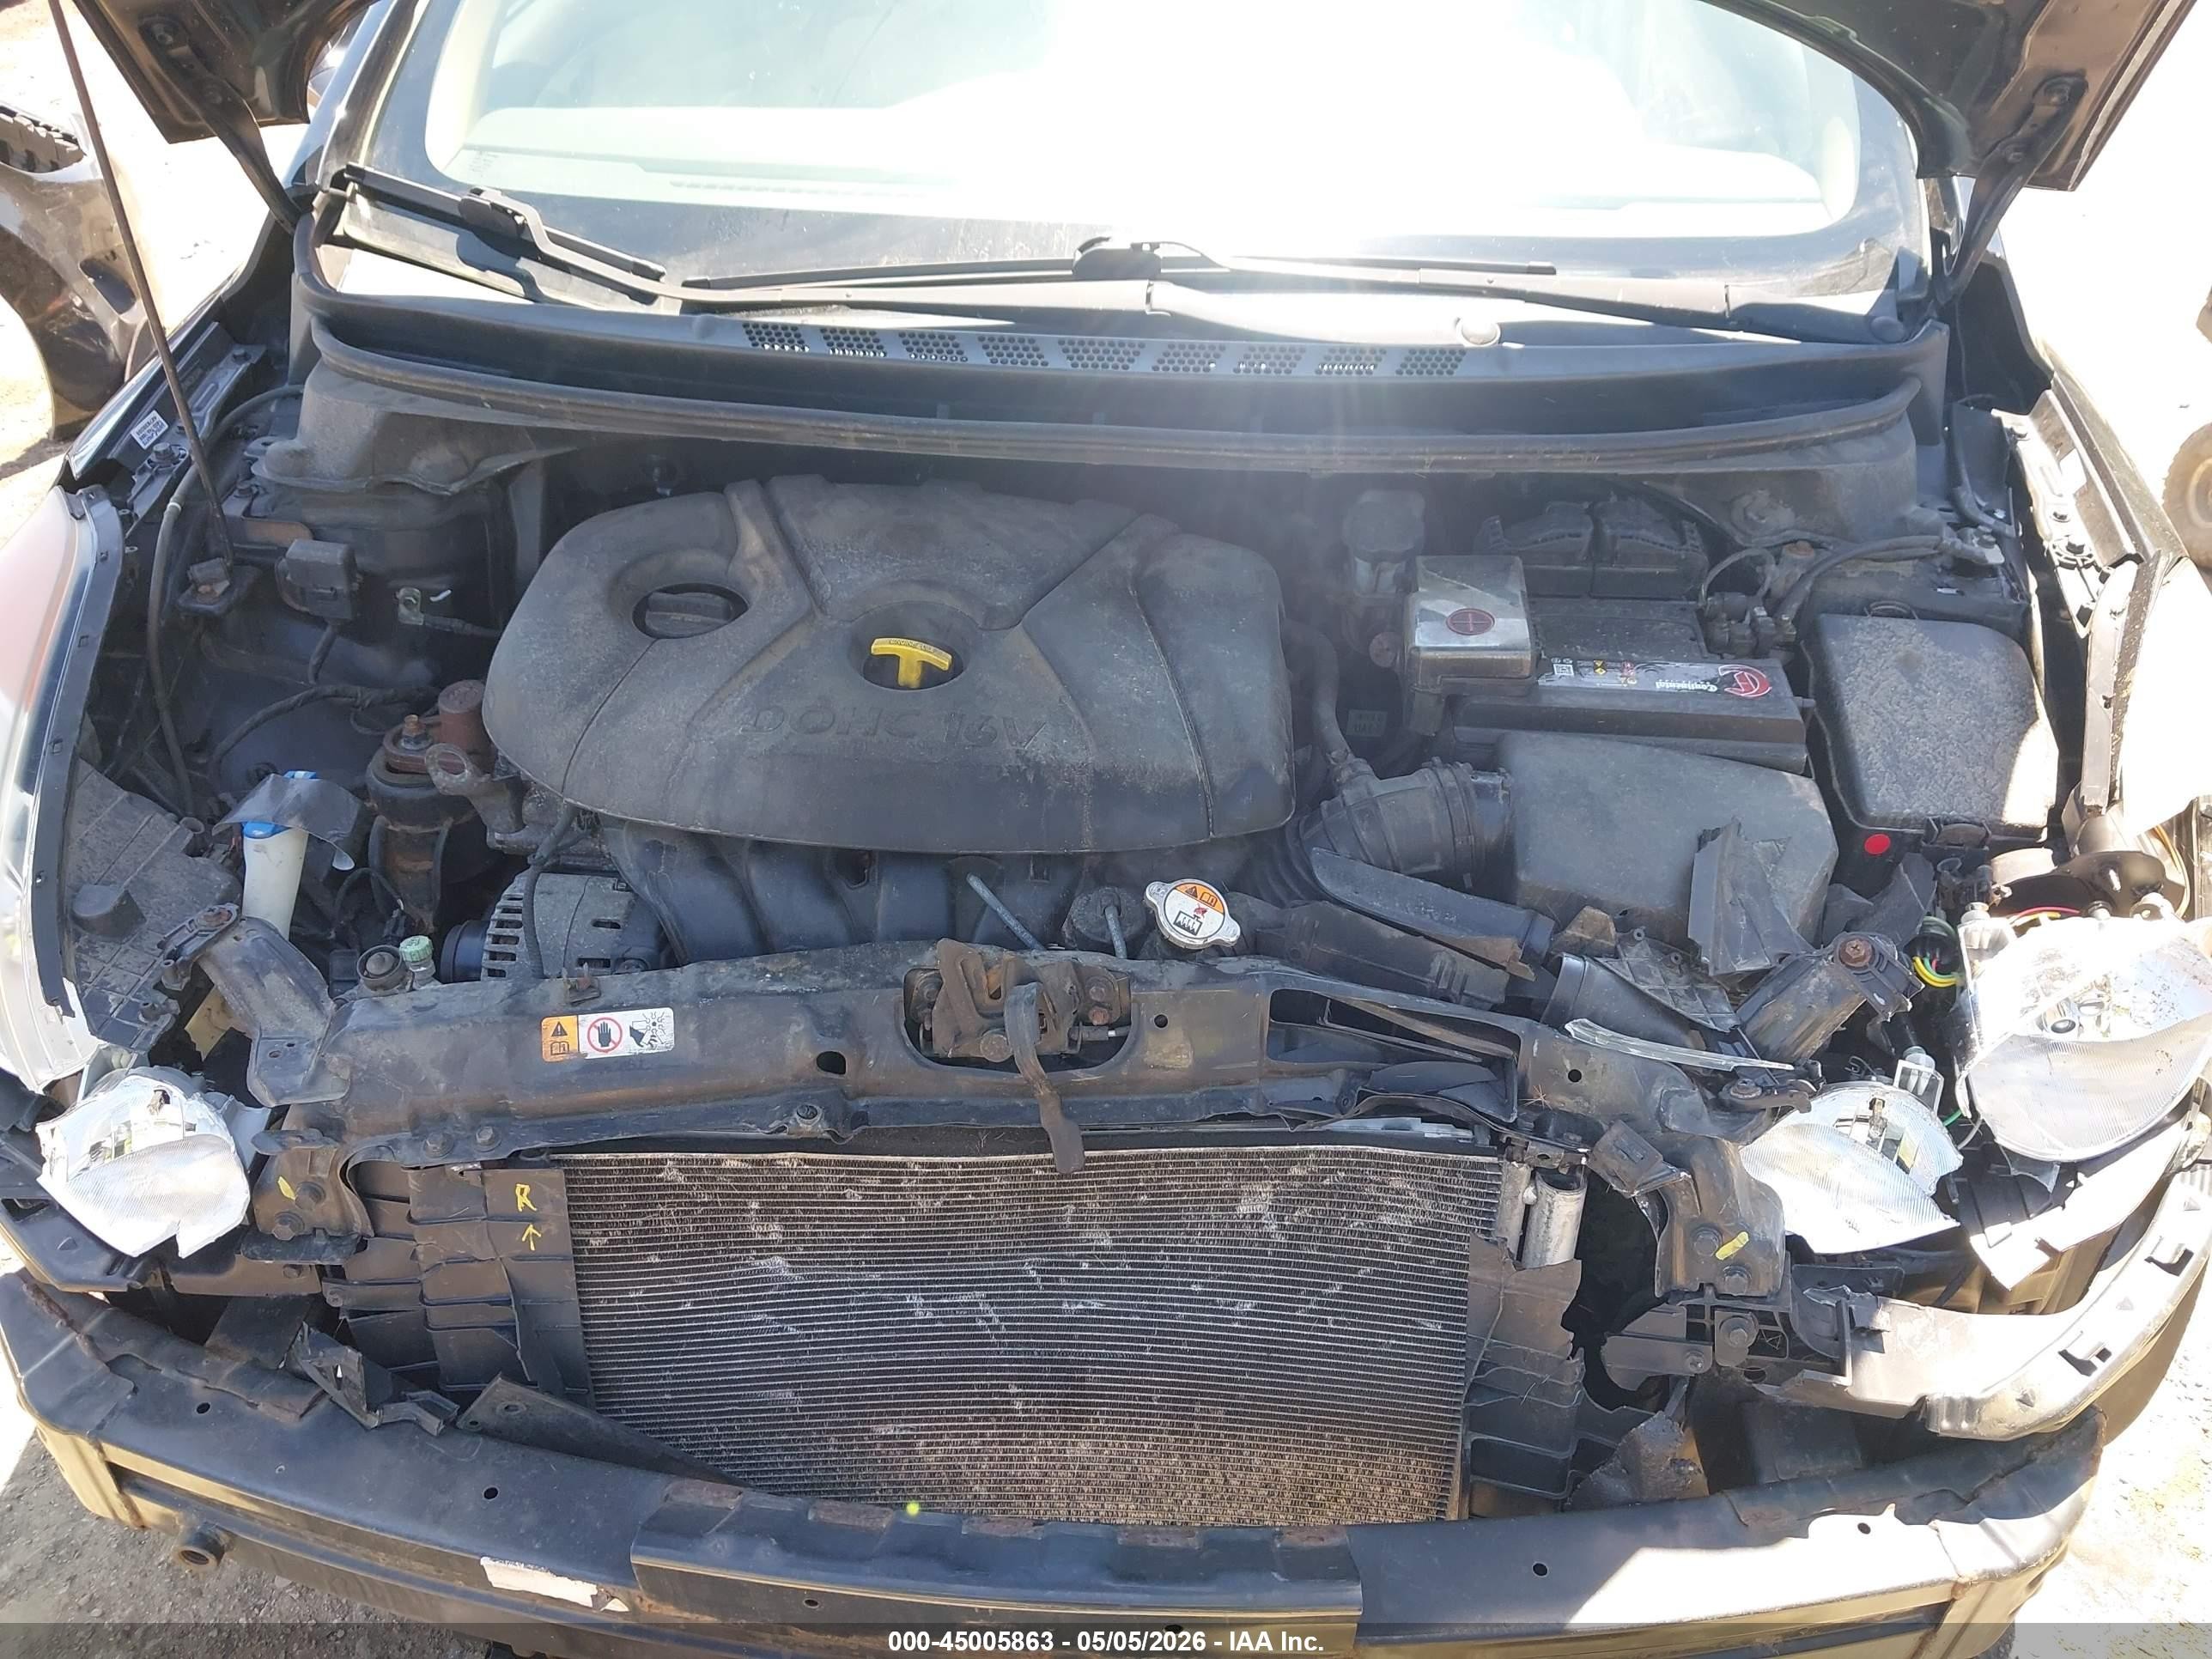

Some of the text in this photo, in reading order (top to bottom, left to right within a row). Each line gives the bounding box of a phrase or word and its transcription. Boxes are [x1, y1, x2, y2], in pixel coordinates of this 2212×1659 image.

[1655, 678, 1717, 692] Continental
[738, 705, 1047, 750] DOHC 16V
[515, 1183, 538, 1212] R
